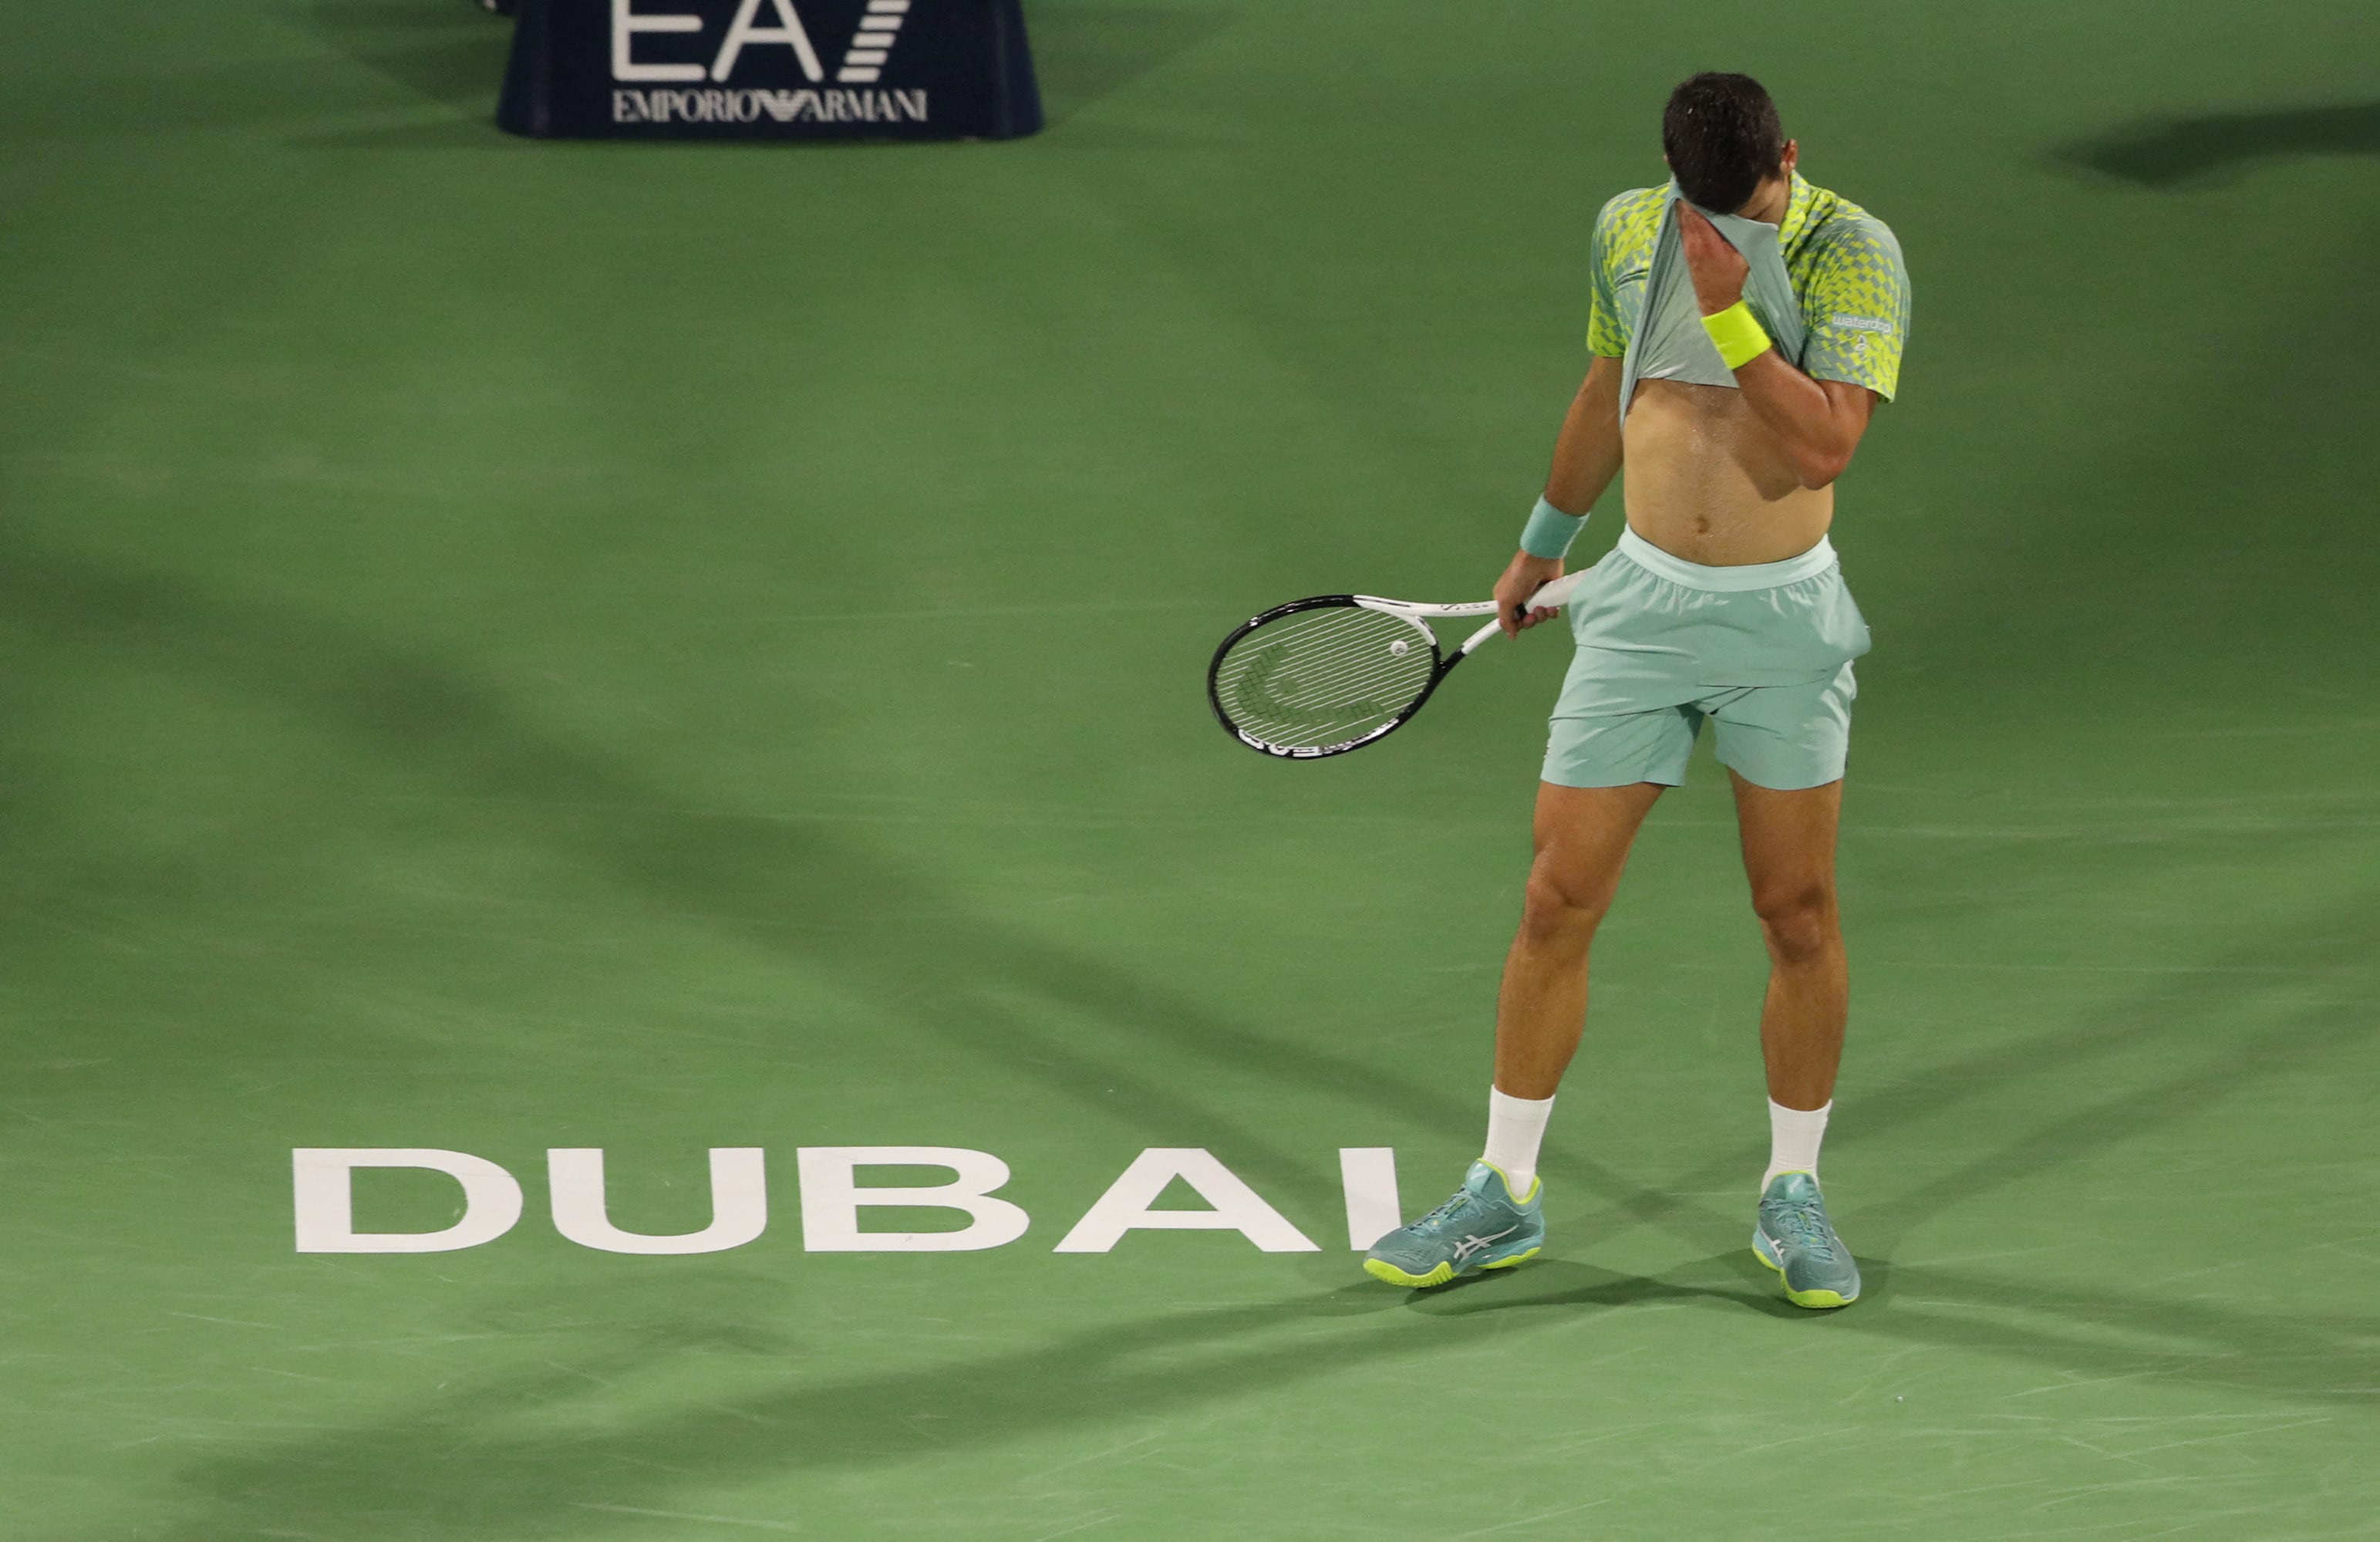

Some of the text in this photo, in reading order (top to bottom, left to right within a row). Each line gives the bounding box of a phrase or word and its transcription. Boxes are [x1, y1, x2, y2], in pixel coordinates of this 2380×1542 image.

[612, 0, 910, 83] EA7
[613, 89, 927, 122] EMPORIO ARMANI
[292, 1146, 1401, 1255] DUBAI
